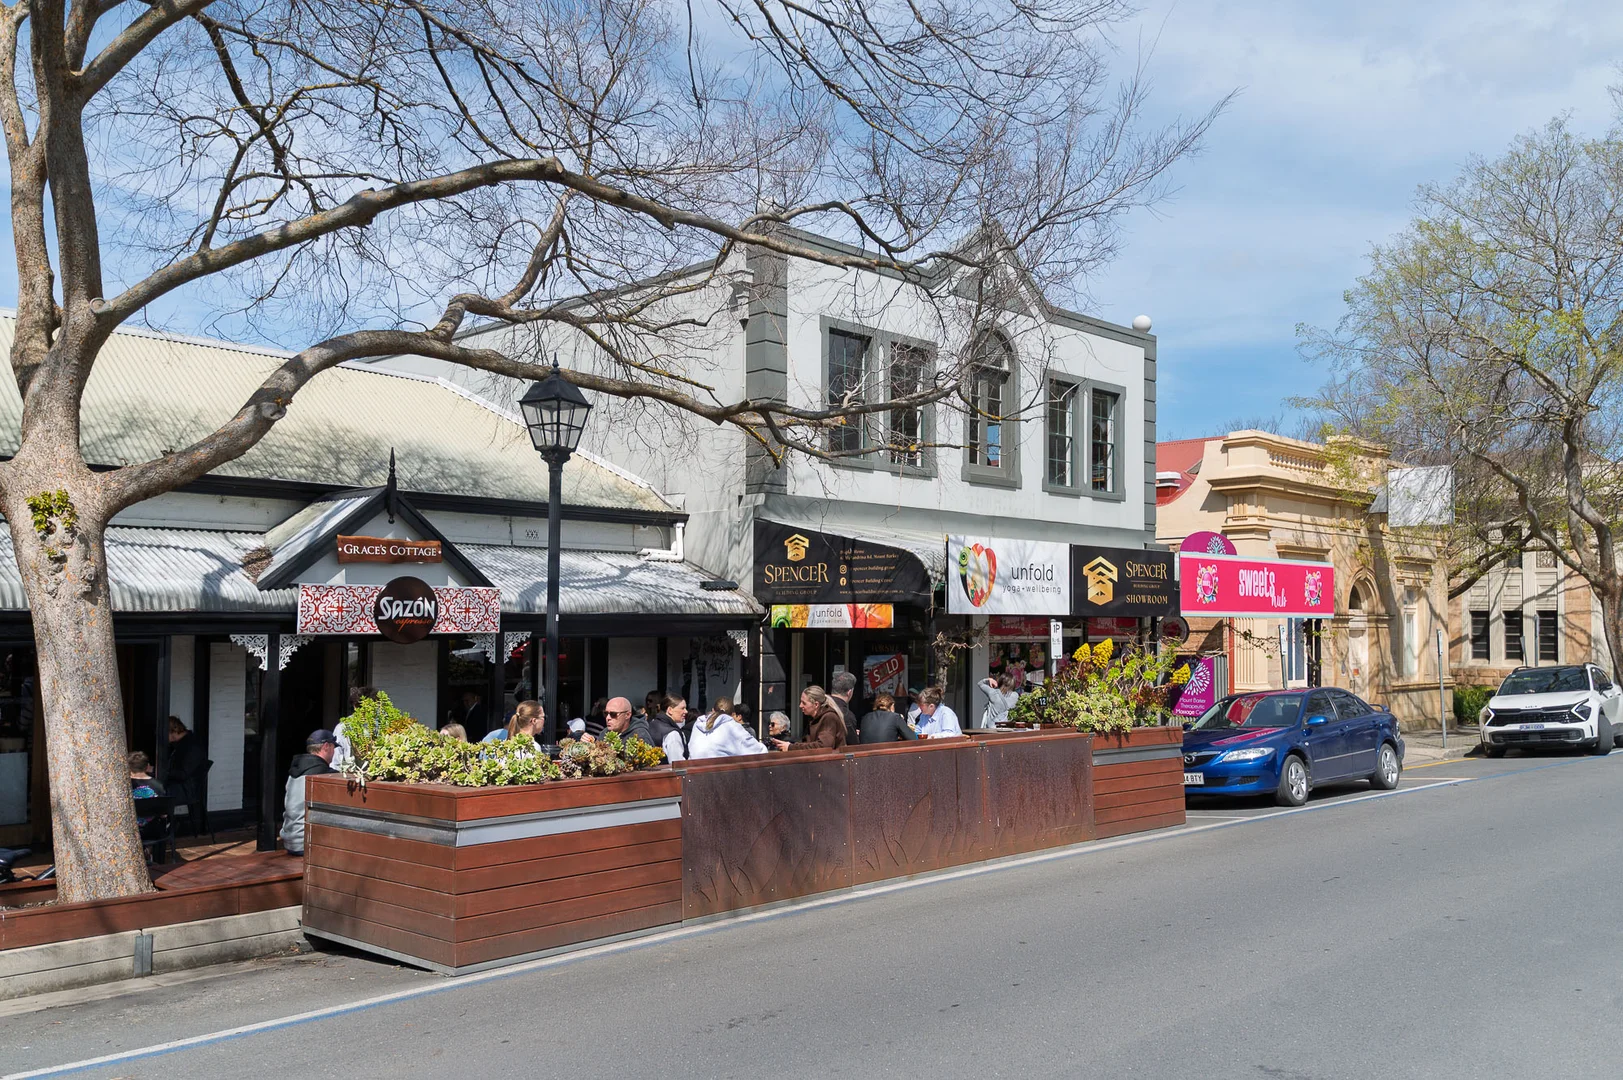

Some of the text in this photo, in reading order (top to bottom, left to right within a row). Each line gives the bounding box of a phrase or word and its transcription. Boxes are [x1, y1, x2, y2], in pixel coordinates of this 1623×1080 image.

[343, 543, 437, 557] GRACE'S COTTAGE
[764, 562, 830, 585] SPENCER
[1011, 563, 1054, 581] unfold
[1125, 560, 1168, 580] SPENCER
[1238, 566, 1276, 598] sweets
[1125, 594, 1168, 604] SHOWROOM
[815, 607, 843, 618] unfold
[396, 618, 432, 632] espresso
